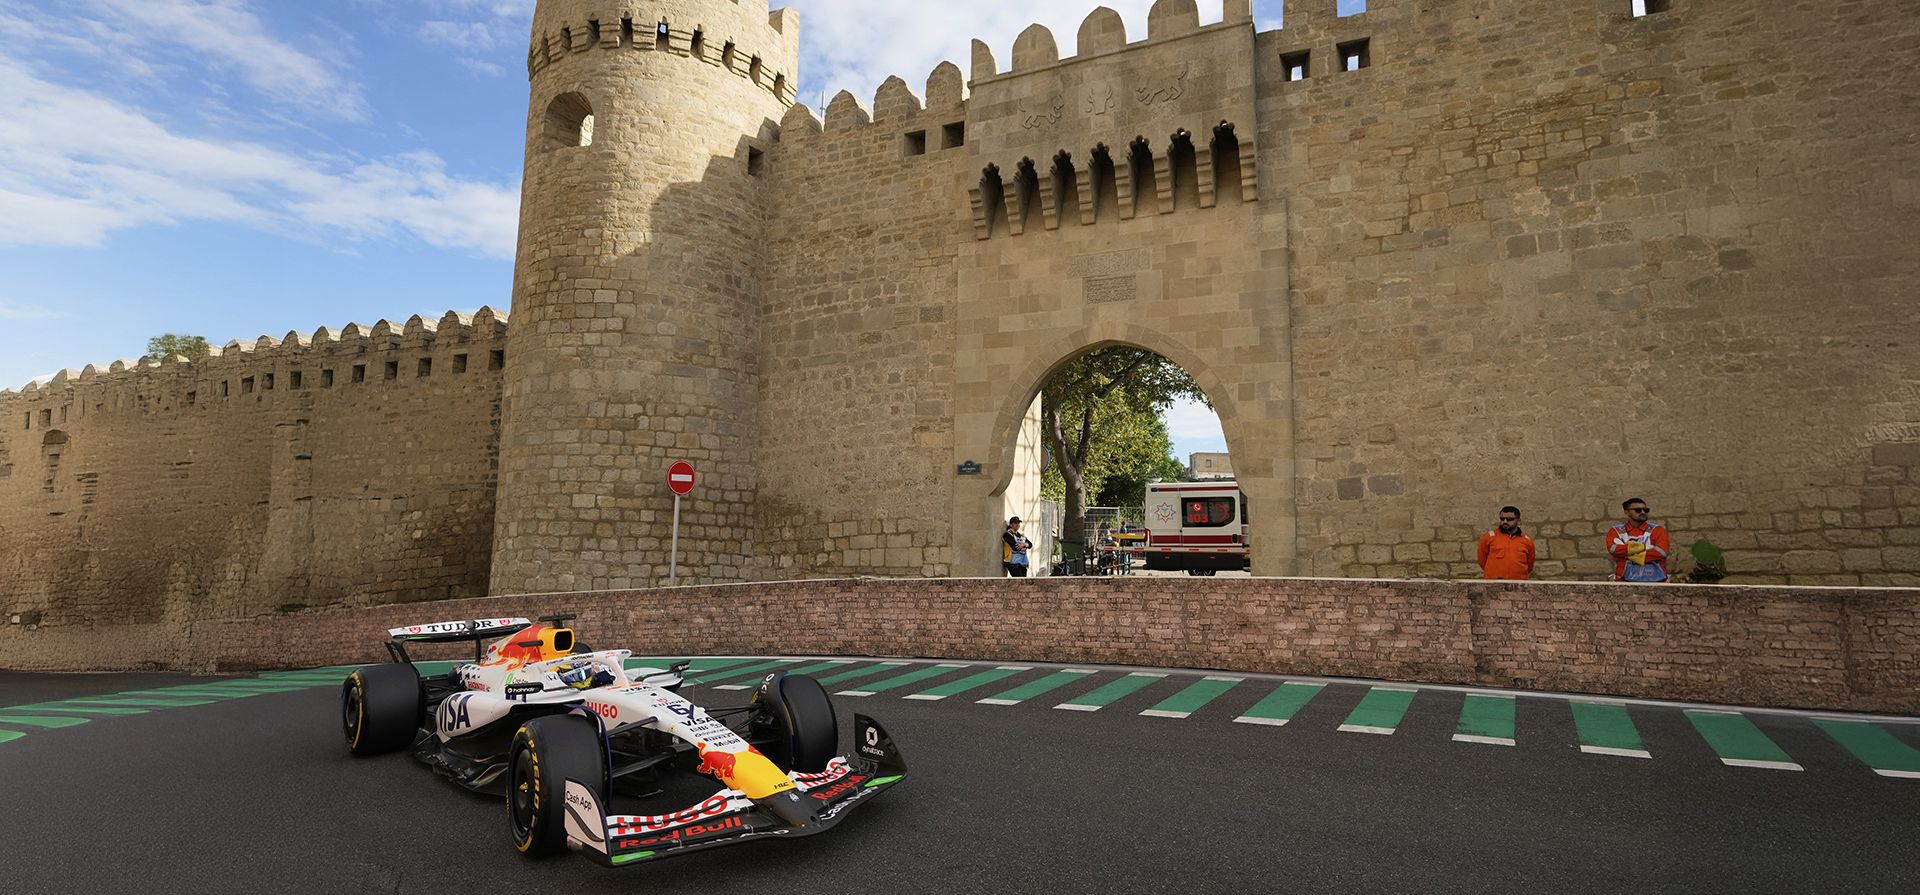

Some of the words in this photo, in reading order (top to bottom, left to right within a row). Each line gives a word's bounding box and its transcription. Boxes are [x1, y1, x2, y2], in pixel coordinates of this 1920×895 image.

[586, 701, 618, 719] HUGO
[681, 716, 715, 726] VISA
[528, 739, 535, 748] P
[531, 752, 540, 810] ZERO
[565, 790, 580, 805] Cash
[580, 796, 592, 811] App
[616, 795, 728, 834] HUGO
[620, 830, 680, 848] Red
[685, 816, 743, 837] Bull
